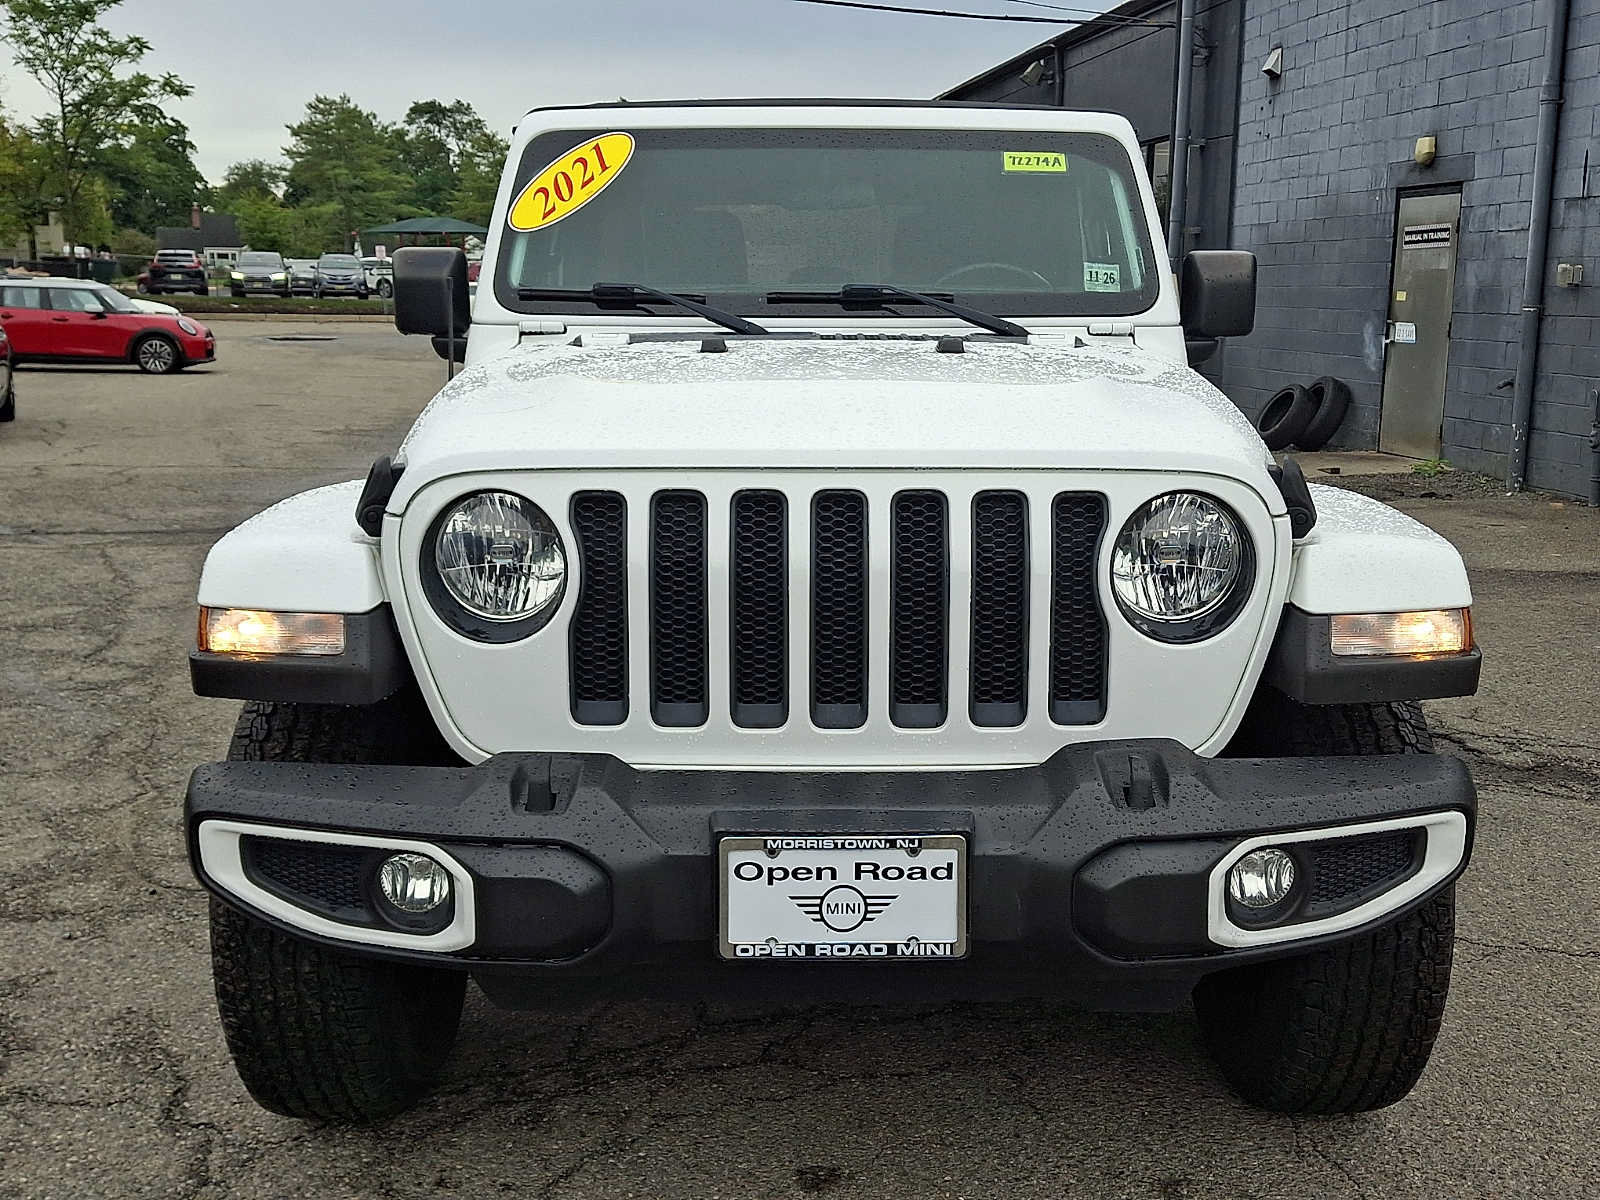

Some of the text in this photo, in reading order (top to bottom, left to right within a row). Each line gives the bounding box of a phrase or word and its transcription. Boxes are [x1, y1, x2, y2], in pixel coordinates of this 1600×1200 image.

[532, 142, 611, 221] 2021
[1103, 272, 1116, 284] 26
[767, 839, 919, 849] MORRISTOWN, NJ
[733, 861, 954, 886] Open Road
[826, 902, 862, 915] MINI
[735, 943, 952, 957] OPEN ROAD MINI
